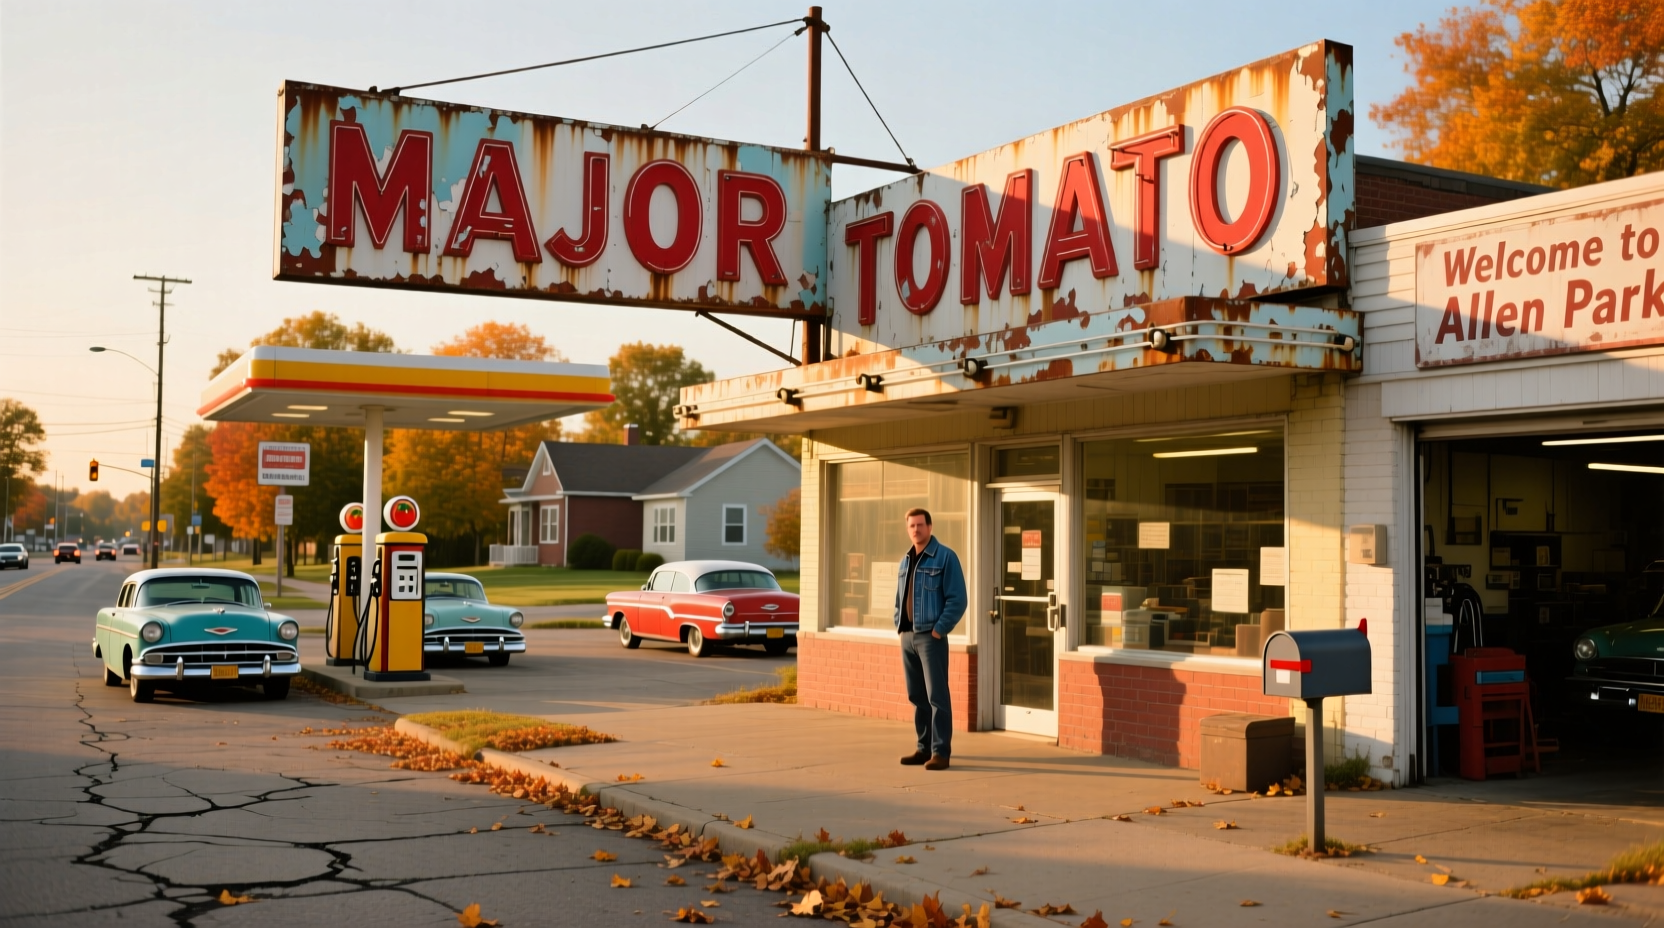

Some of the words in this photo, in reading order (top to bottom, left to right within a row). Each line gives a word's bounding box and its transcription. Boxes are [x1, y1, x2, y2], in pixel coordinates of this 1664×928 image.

[326, 120, 788, 286] MAJOR
[845, 106, 1280, 326] TOMATO
[1444, 237, 1603, 287] Welcome
[1620, 224, 1660, 261] to
[1434, 290, 1545, 344] Allen
[1564, 268, 1664, 329] Park
